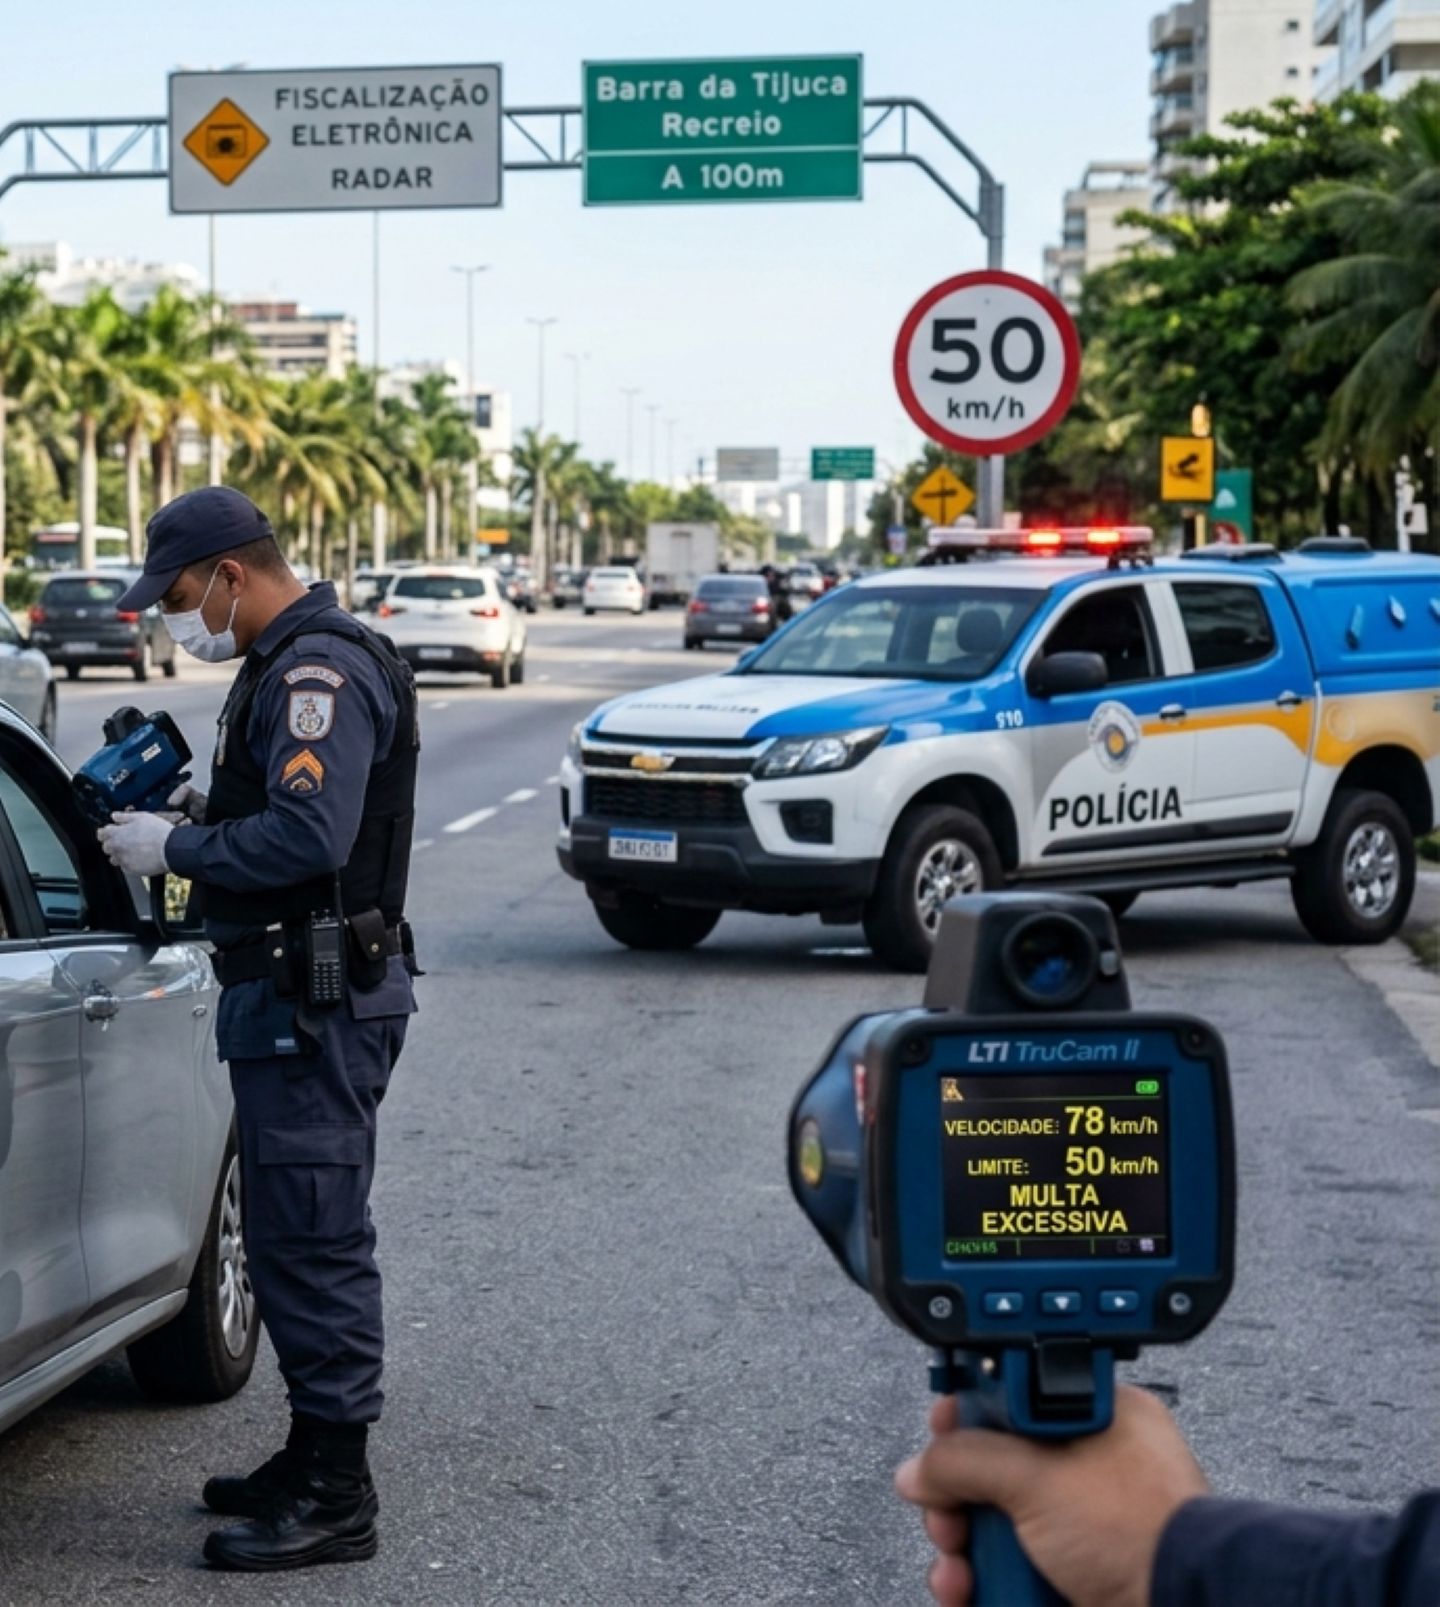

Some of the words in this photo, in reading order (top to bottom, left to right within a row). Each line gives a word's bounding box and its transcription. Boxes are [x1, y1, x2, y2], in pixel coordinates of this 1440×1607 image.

[274, 78, 489, 111] FISCALIZAÇÃO
[596, 76, 685, 101] Barra
[699, 74, 737, 99] da
[751, 70, 848, 104] Tijuca
[291, 117, 474, 147] ELETRÔNICA
[662, 110, 782, 137] Recreio
[331, 166, 433, 190] RADAR
[661, 164, 684, 190] A
[700, 162, 784, 189] 100m
[929, 316, 1045, 384] 50
[947, 395, 1025, 422] km/h
[1048, 782, 1182, 831] POLÍCIA
[968, 1040, 1010, 1063] LTI
[1015, 1039, 1118, 1062] TruCam
[944, 1118, 1060, 1137] VELOCIDADE:
[1064, 1105, 1105, 1137] 78
[1109, 1115, 1159, 1136] km/h
[967, 1158, 1031, 1177] LIMITE:
[1065, 1145, 1105, 1177] 50
[1109, 1155, 1160, 1176] km/h
[1010, 1183, 1101, 1208] MULTA
[982, 1209, 1129, 1235] EXCESSIVA
